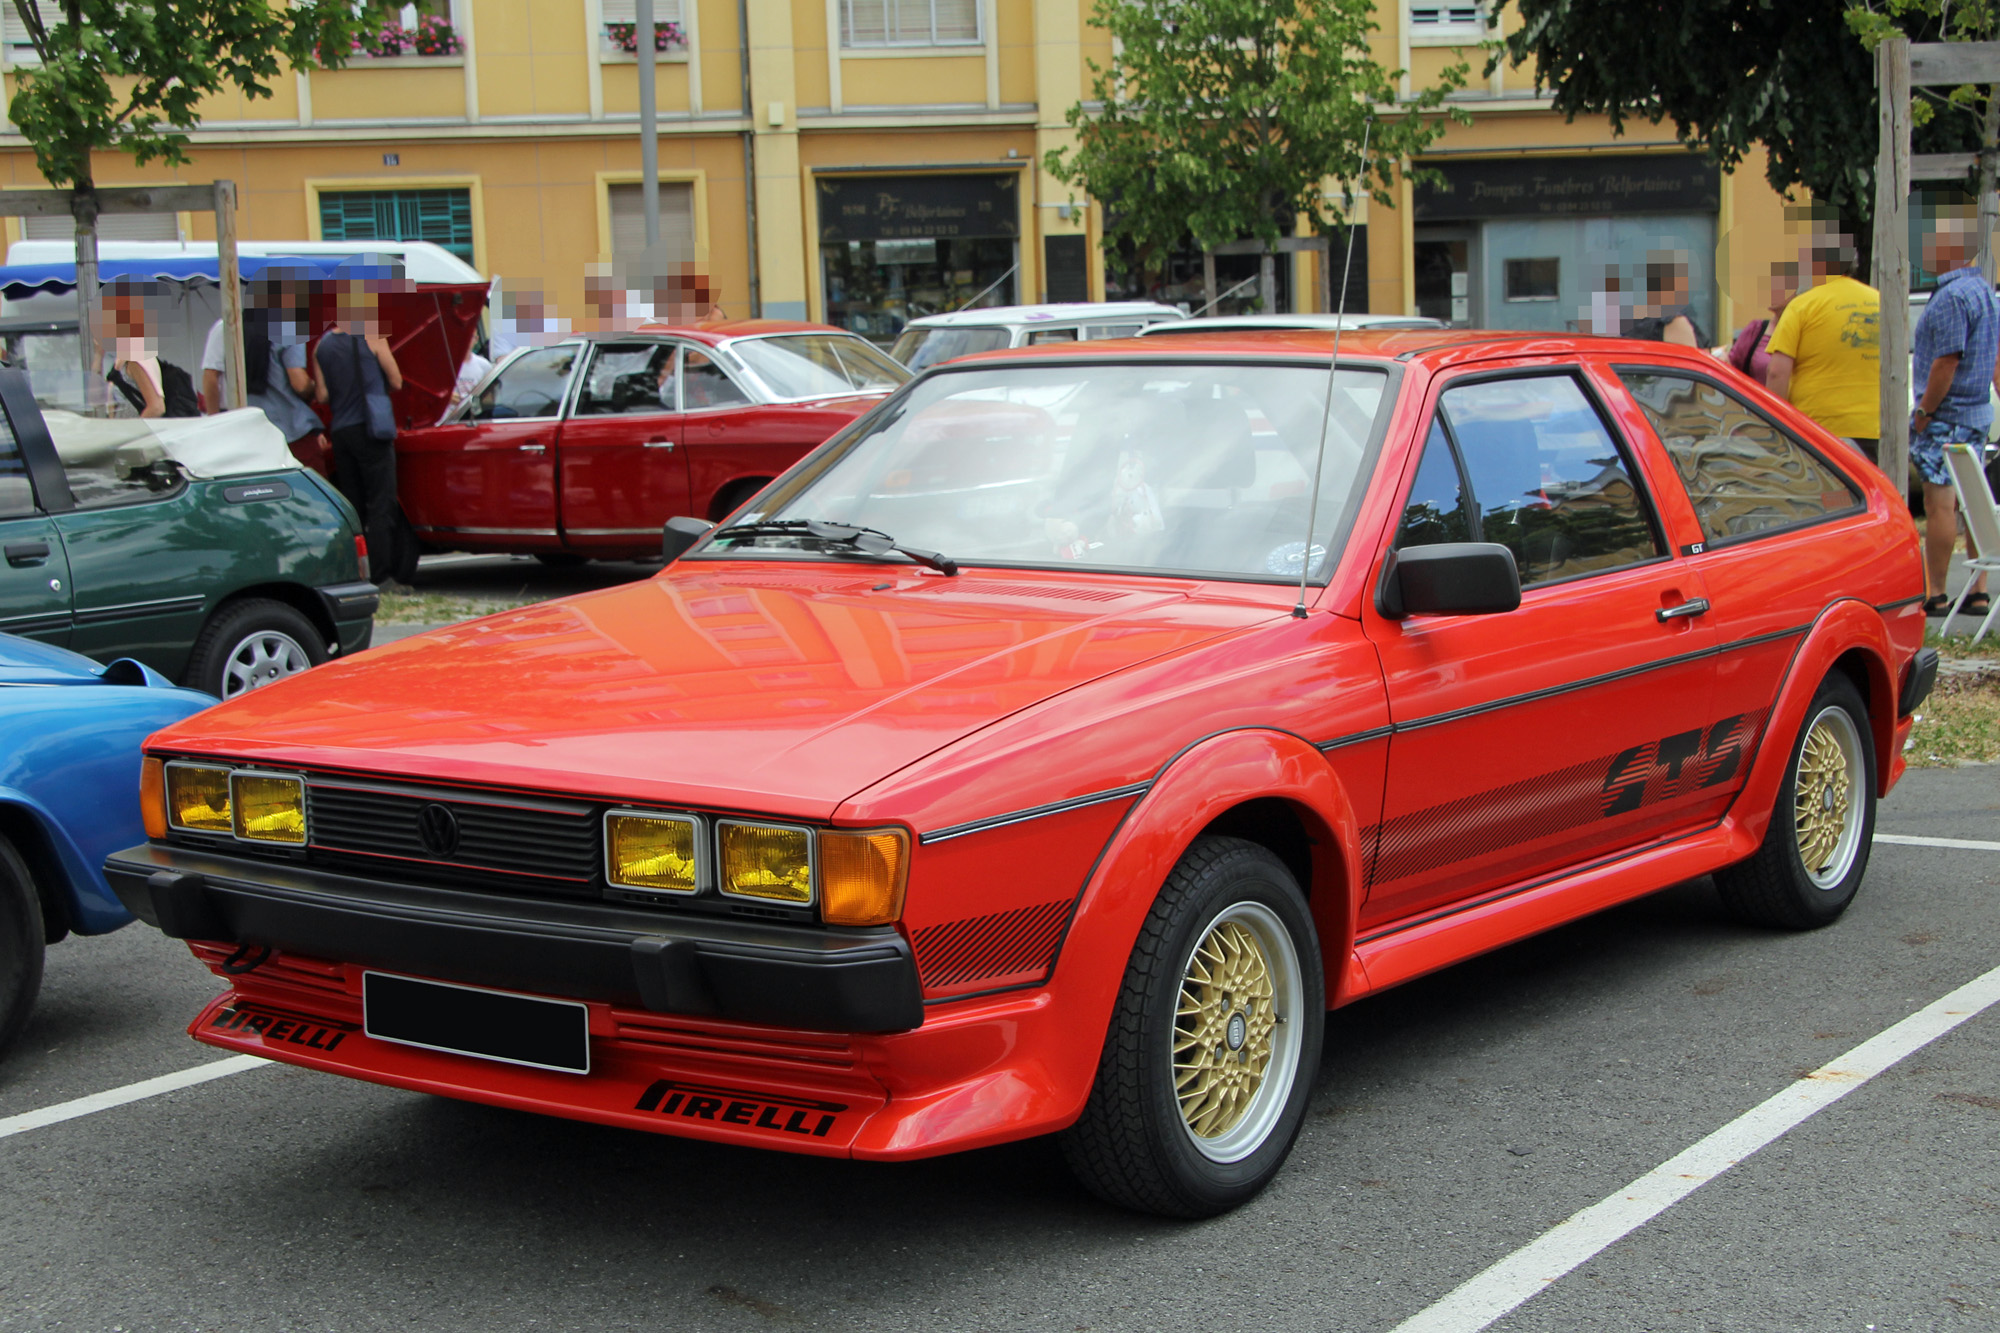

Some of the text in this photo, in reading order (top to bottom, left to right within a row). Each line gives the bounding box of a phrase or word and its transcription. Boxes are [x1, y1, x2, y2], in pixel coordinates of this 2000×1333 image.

[1468, 181, 1525, 203] Pompes
[1598, 174, 1682, 198] Belfortaines
[1691, 543, 1704, 555] GT
[211, 1001, 364, 1051] PIRELLI
[634, 1079, 849, 1137] PIRELLI
